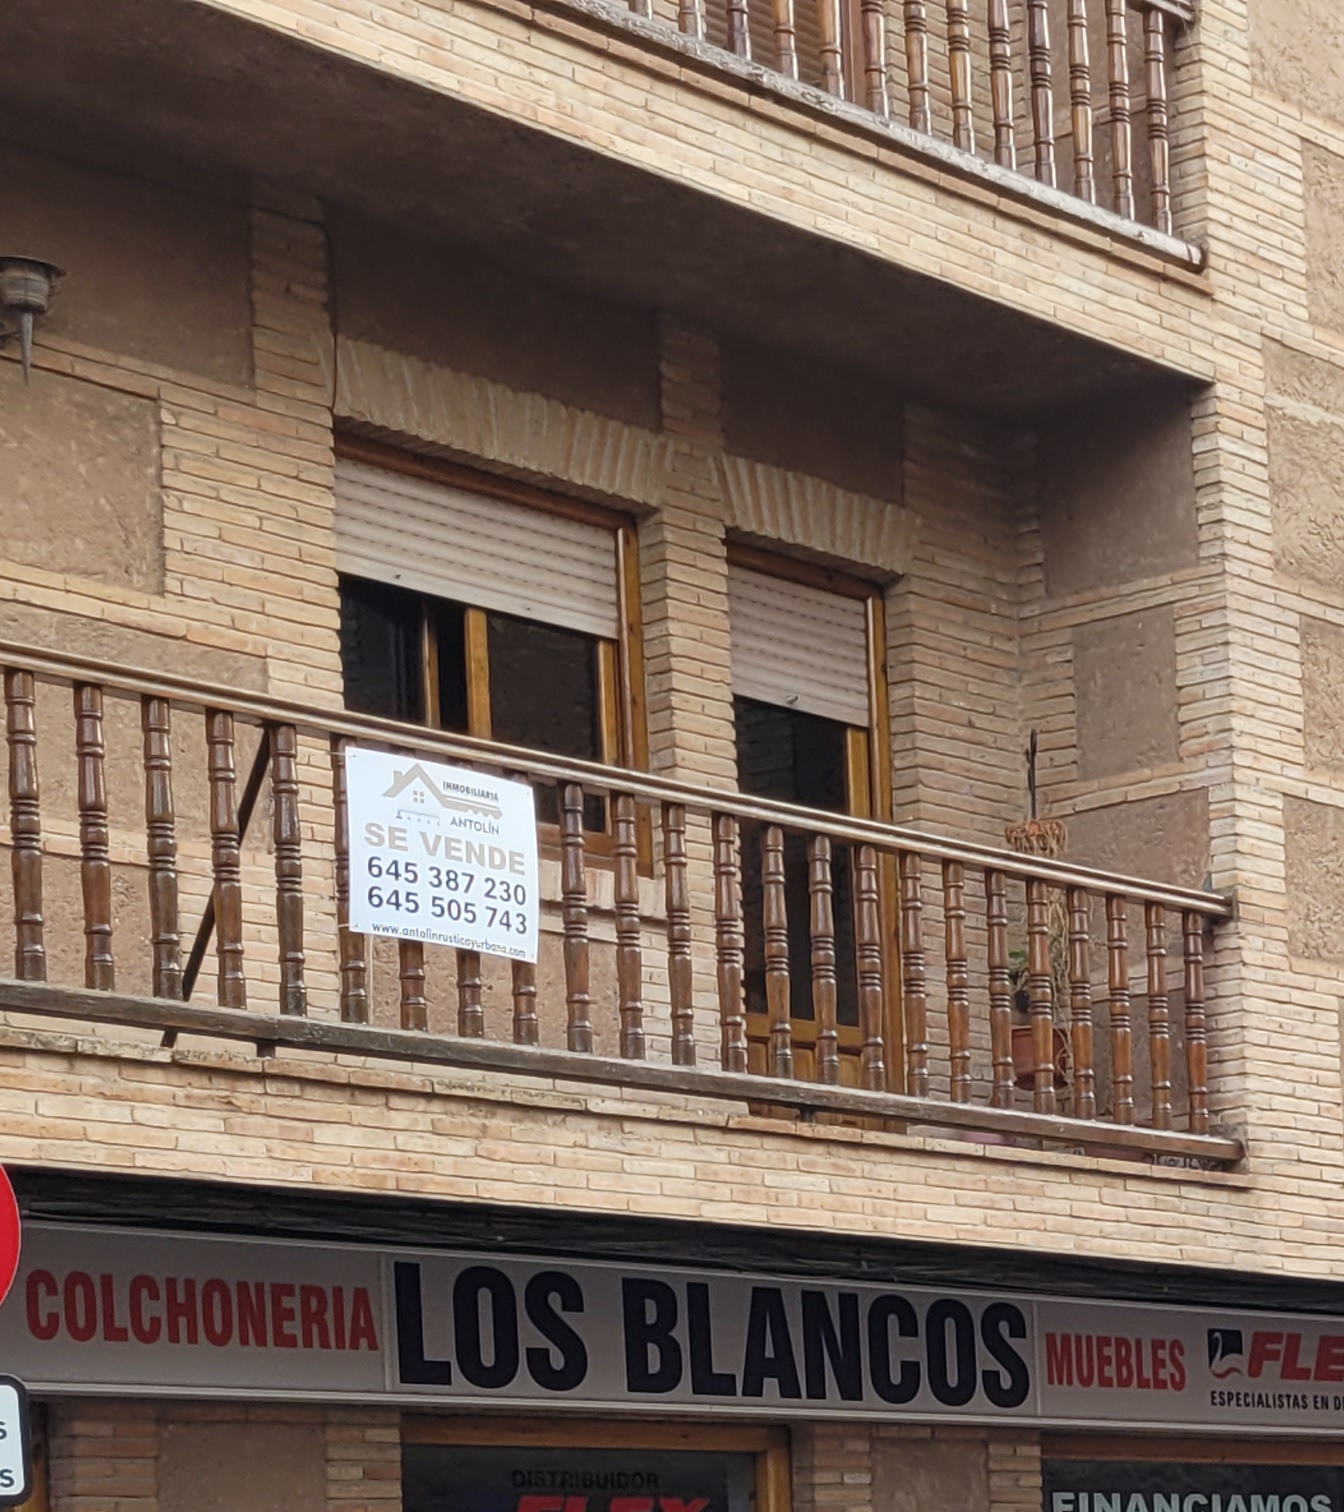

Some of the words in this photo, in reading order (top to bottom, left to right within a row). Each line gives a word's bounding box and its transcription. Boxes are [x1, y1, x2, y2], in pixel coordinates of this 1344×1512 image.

[443, 781, 499, 802] INMOBILIARIA
[364, 822, 409, 852] SE
[419, 831, 526, 876] VENDE
[450, 816, 500, 835] ANTOLÍN
[367, 856, 419, 883] 645
[428, 866, 475, 894] 387
[484, 877, 527, 906] 230
[367, 886, 420, 914] 645
[431, 896, 478, 924] 505
[485, 907, 528, 935] 743
[26, 1268, 380, 1352] COLCHONERIA
[394, 1261, 588, 1392] LOS
[622, 1277, 1030, 1408] BLANCOS
[1045, 1331, 1187, 1392] MUEBLES
[1210, 1390, 1308, 1410] ESPECIALISTAS
[1313, 1395, 1329, 1411] EN
[512, 1470, 659, 1489] DISTRIBUIDOR
